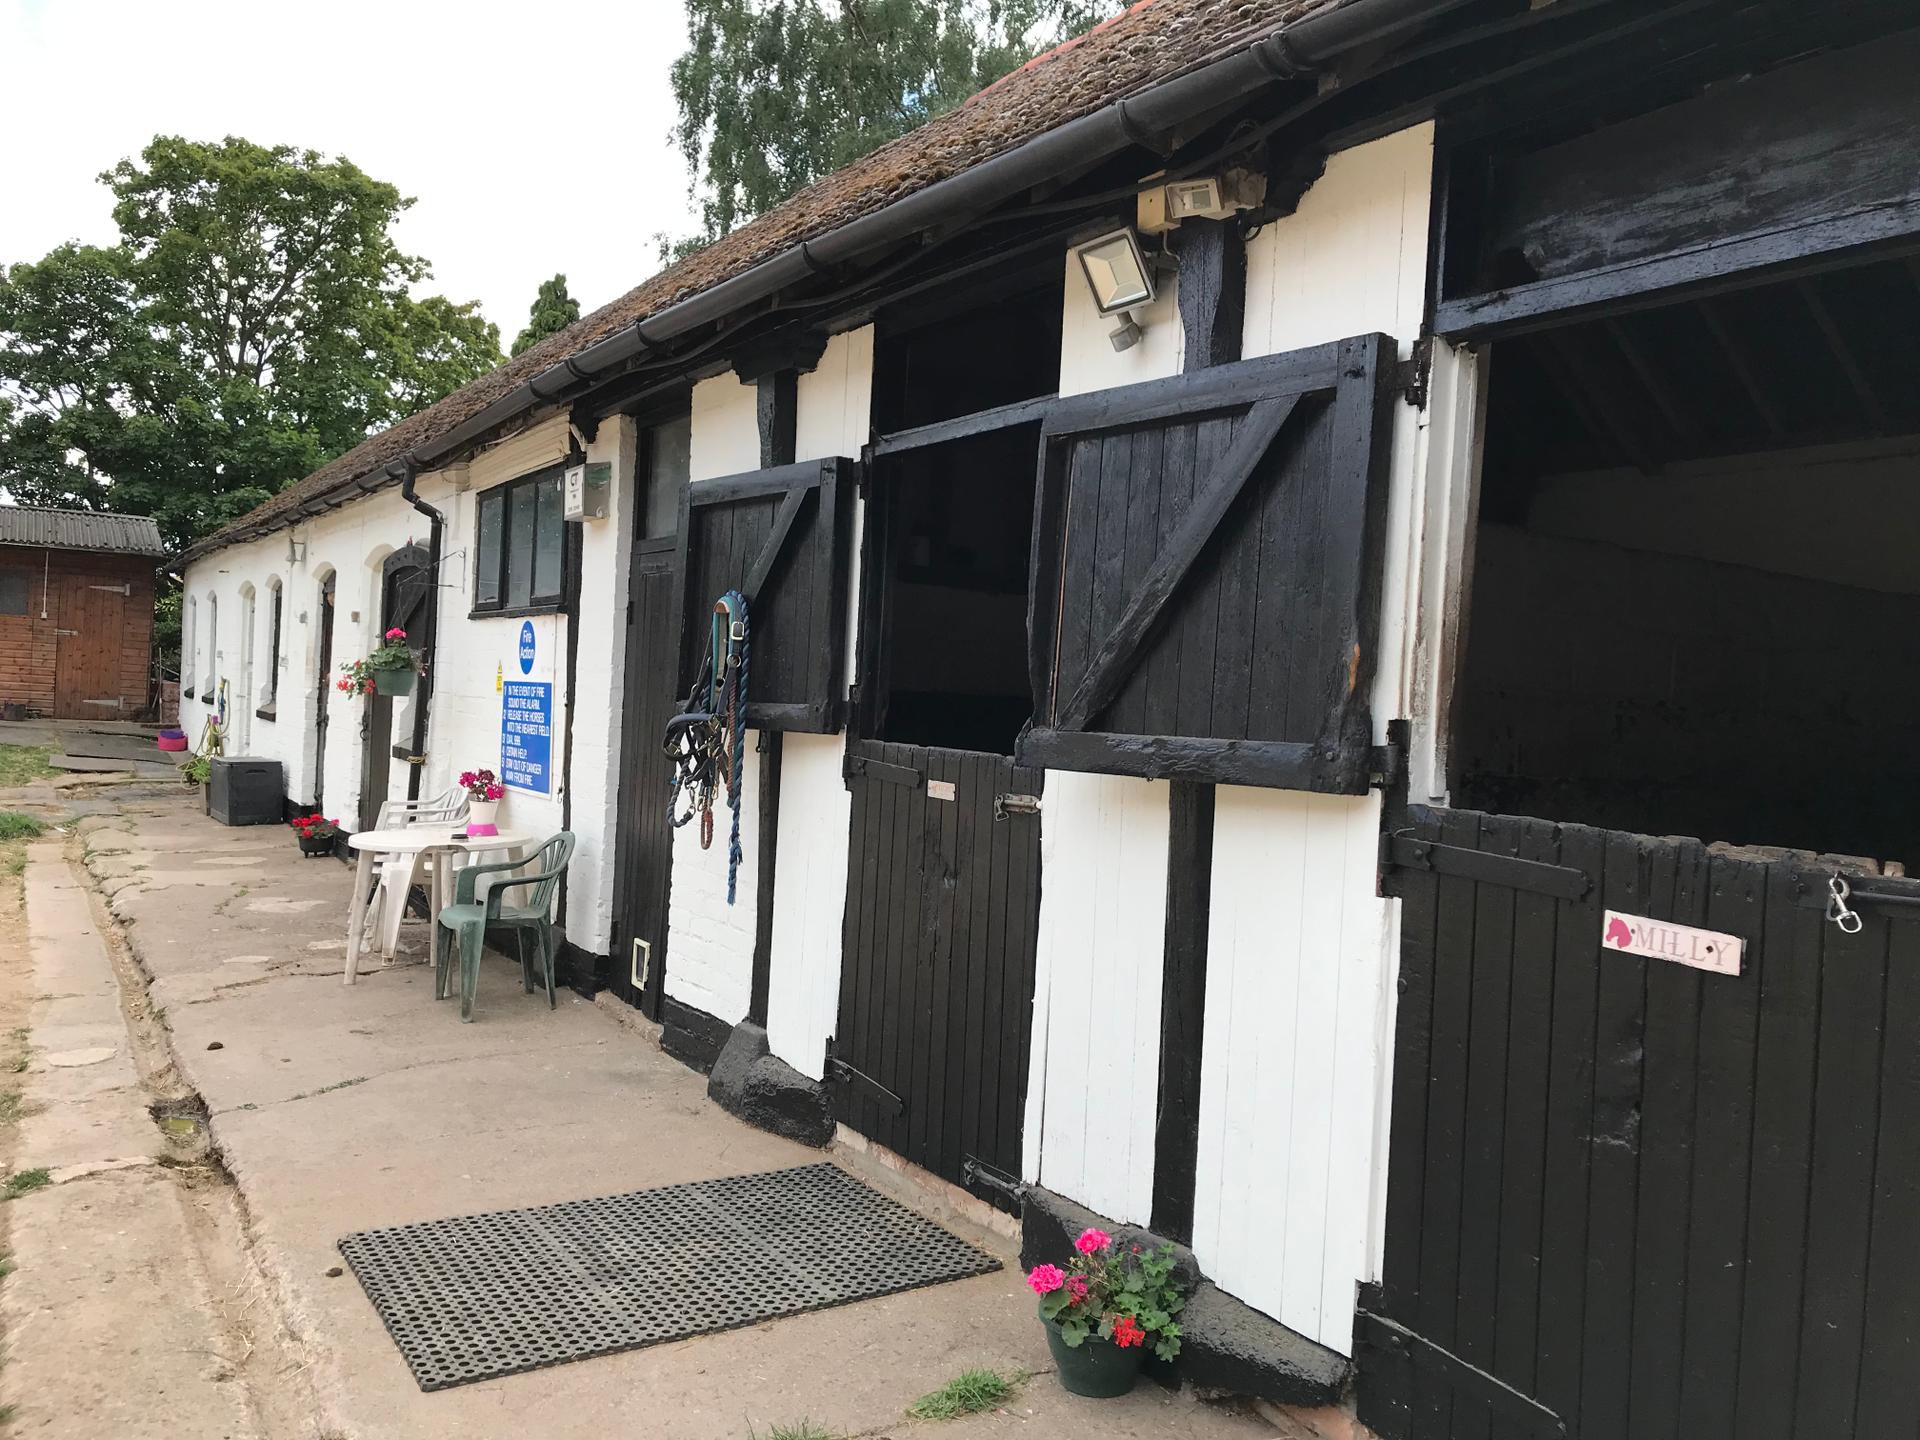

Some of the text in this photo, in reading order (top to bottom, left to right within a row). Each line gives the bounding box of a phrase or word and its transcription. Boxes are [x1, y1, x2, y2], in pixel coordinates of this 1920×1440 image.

[523, 630, 532, 643] Fire
[520, 646, 535, 659] Action
[519, 686, 530, 697] EVENT
[531, 686, 536, 697] OF
[536, 686, 545, 698] FIRE
[508, 697, 519, 708] SOUND
[507, 709, 522, 721] RELEASE
[529, 711, 545, 723] HORSES
[507, 721, 515, 733] INTO
[522, 723, 538, 735] NEAREST
[506, 746, 517, 758] OBTAIN
[513, 759, 521, 770] OUT
[521, 761, 527, 772] OF
[526, 762, 542, 776] DANGER
[513, 772, 524, 784] FROM
[1635, 923, 1732, 966] MILLY
